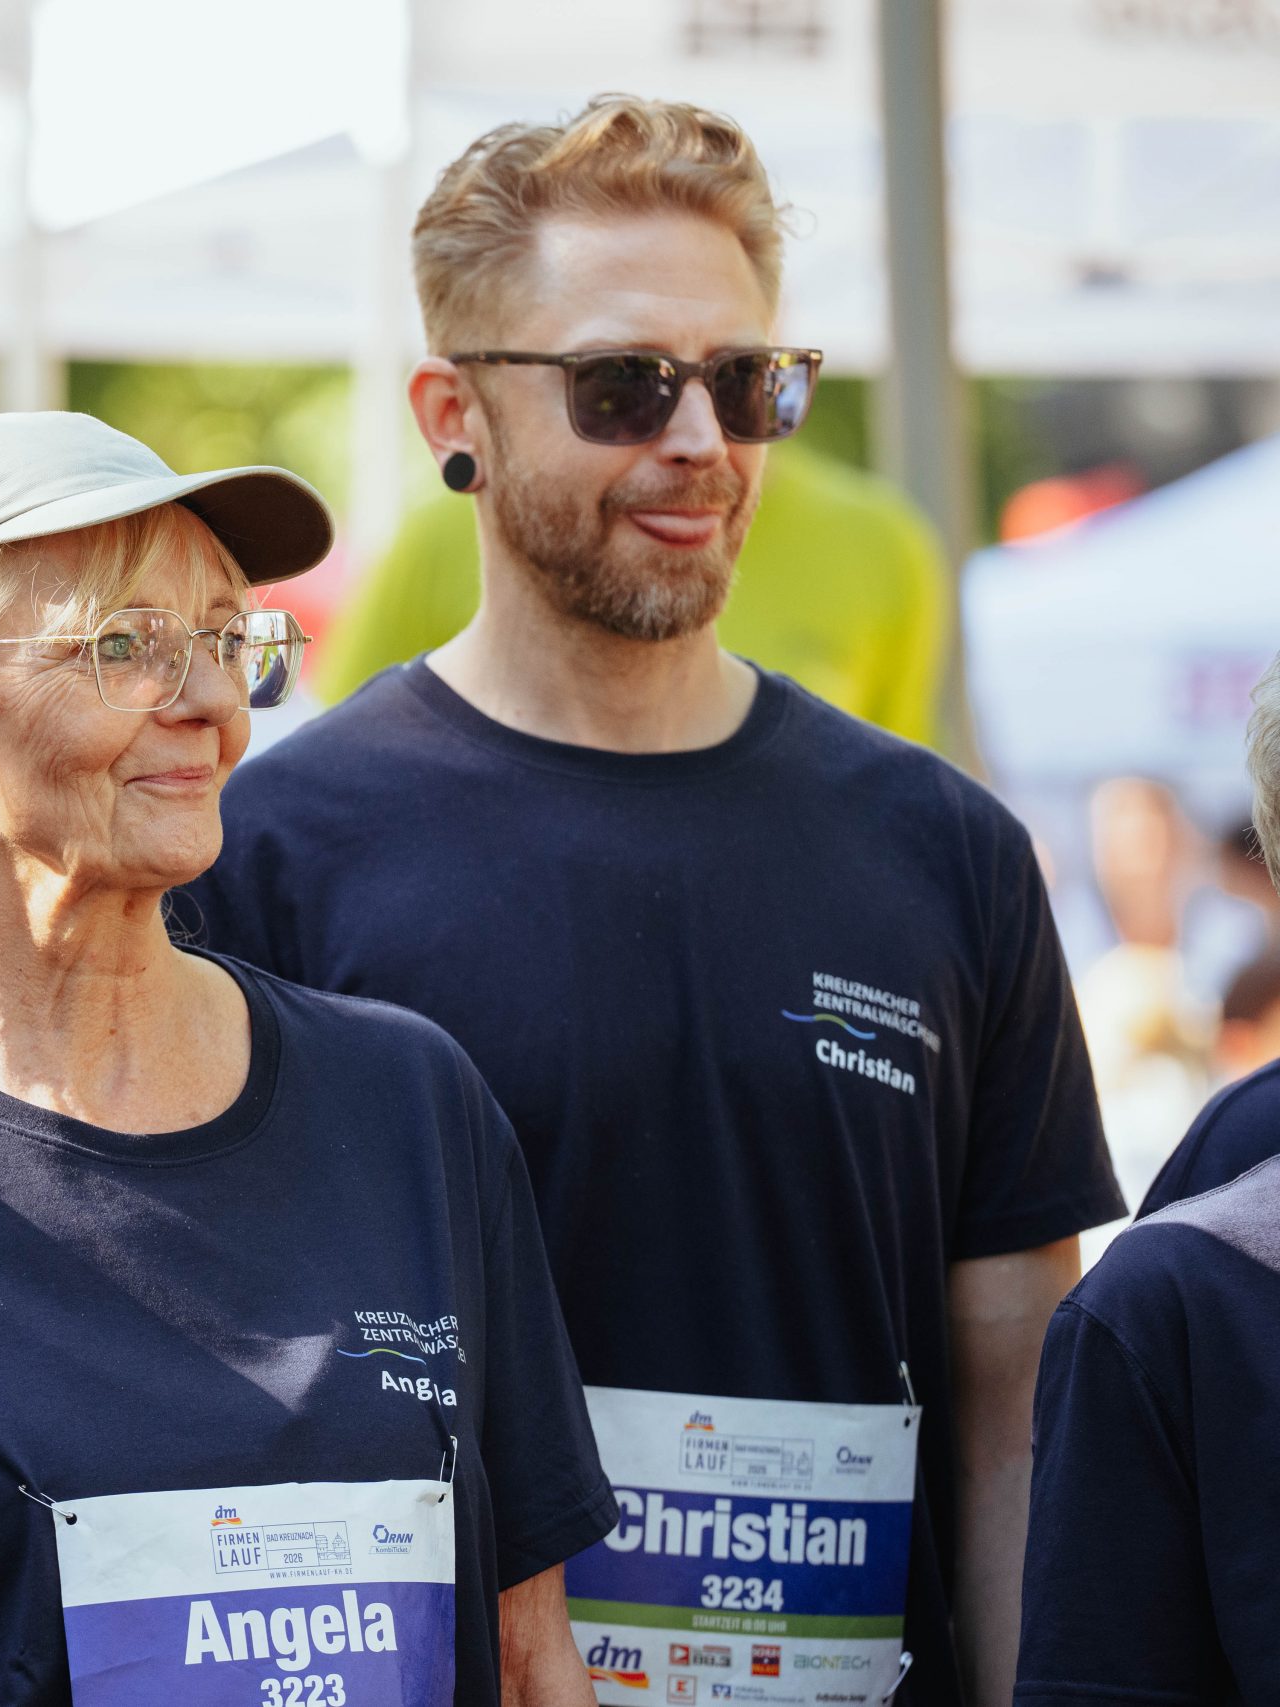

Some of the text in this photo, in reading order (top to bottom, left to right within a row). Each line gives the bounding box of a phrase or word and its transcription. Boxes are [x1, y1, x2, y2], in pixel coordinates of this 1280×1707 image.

[813, 971, 920, 1018] KREUZNACHER
[815, 1038, 916, 1096] Christian
[354, 1311, 458, 1337] KREUZNACHER
[689, 1410, 713, 1424] dm
[686, 1437, 729, 1451] FIRMEN
[684, 1453, 727, 1471] LAUF
[215, 1505, 237, 1519] dm
[217, 1531, 260, 1546] FIRMEN
[266, 1531, 314, 1542] BAD KREUZNACH
[603, 1488, 868, 1566] Christian
[219, 1547, 261, 1568] LAUF
[283, 1553, 303, 1564] 2026
[700, 1574, 785, 1613] 3234
[184, 1589, 398, 1672] Angela
[586, 1636, 643, 1671] dm
[260, 1673, 347, 1707] 3223
